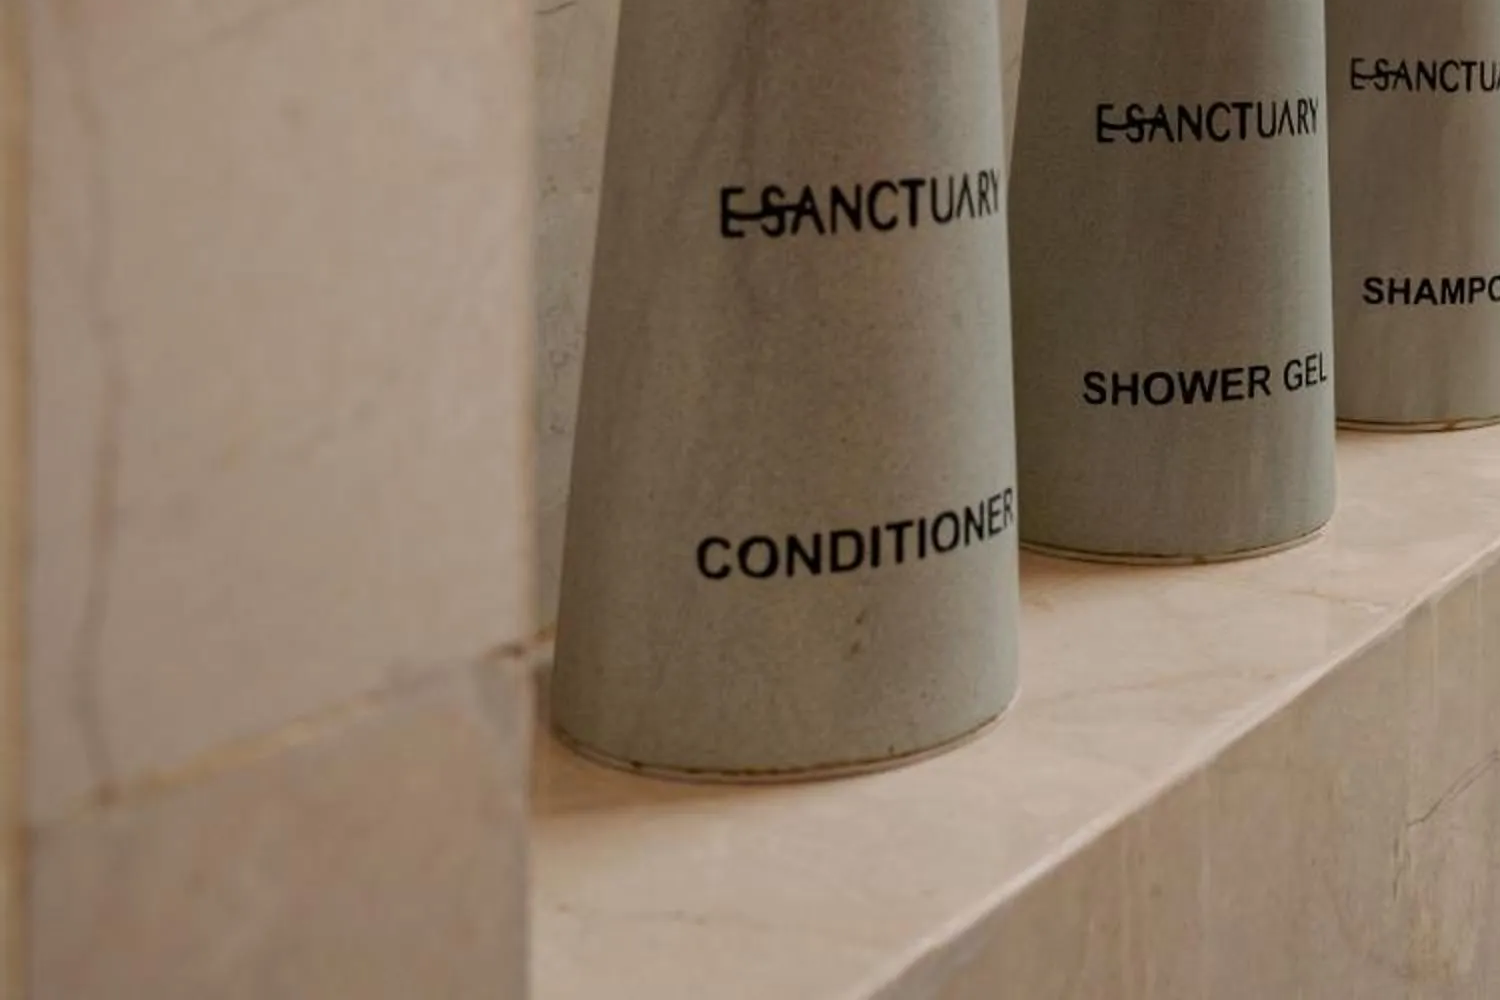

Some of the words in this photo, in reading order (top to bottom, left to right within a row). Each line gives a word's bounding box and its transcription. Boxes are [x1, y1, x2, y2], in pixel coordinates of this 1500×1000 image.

[1082, 365, 1272, 406] SHOWER
[1283, 352, 1327, 392] GEL
[696, 487, 1014, 580] CONDITIONER
